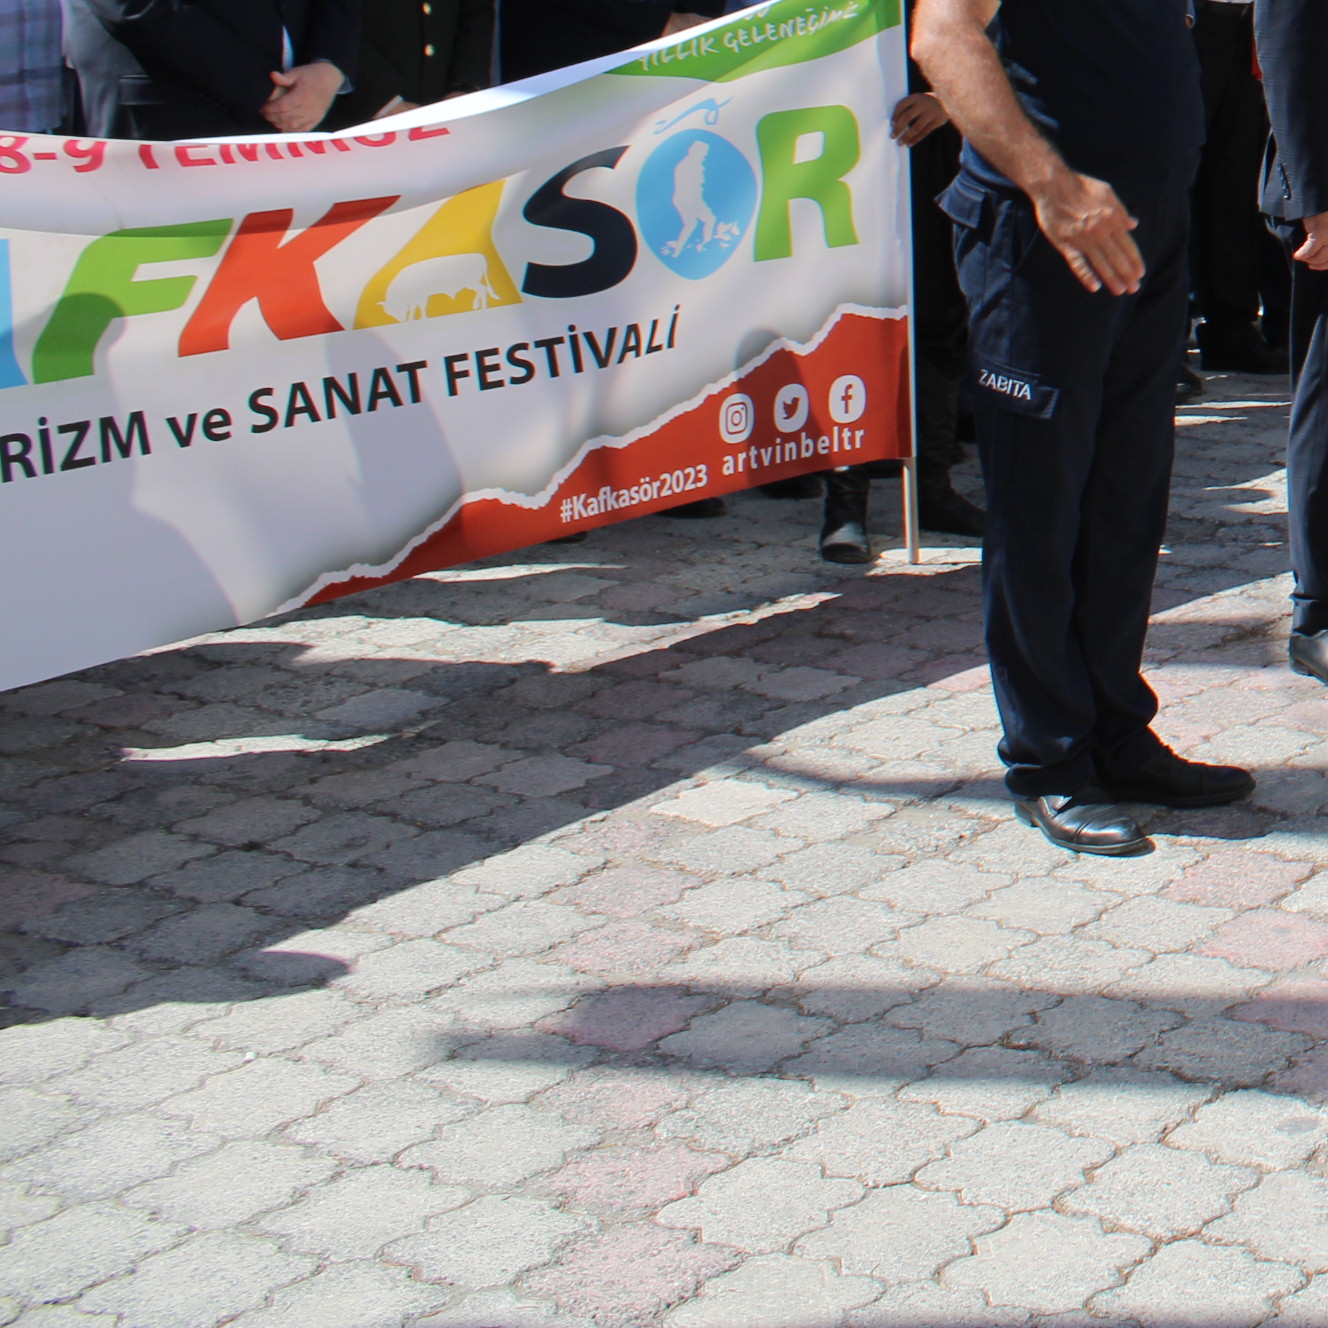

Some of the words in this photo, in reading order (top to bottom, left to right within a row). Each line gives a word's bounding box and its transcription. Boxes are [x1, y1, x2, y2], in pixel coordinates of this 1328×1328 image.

[0, 410, 152, 484] RİZM
[166, 407, 233, 448] ve
[247, 360, 429, 434] SANAT
[443, 303, 681, 397] FESTİVALİ
[978, 368, 1032, 400] ZABITA
[721, 424, 866, 476] artvinbeltr
[560, 463, 708, 524] #Kafkasör2023
